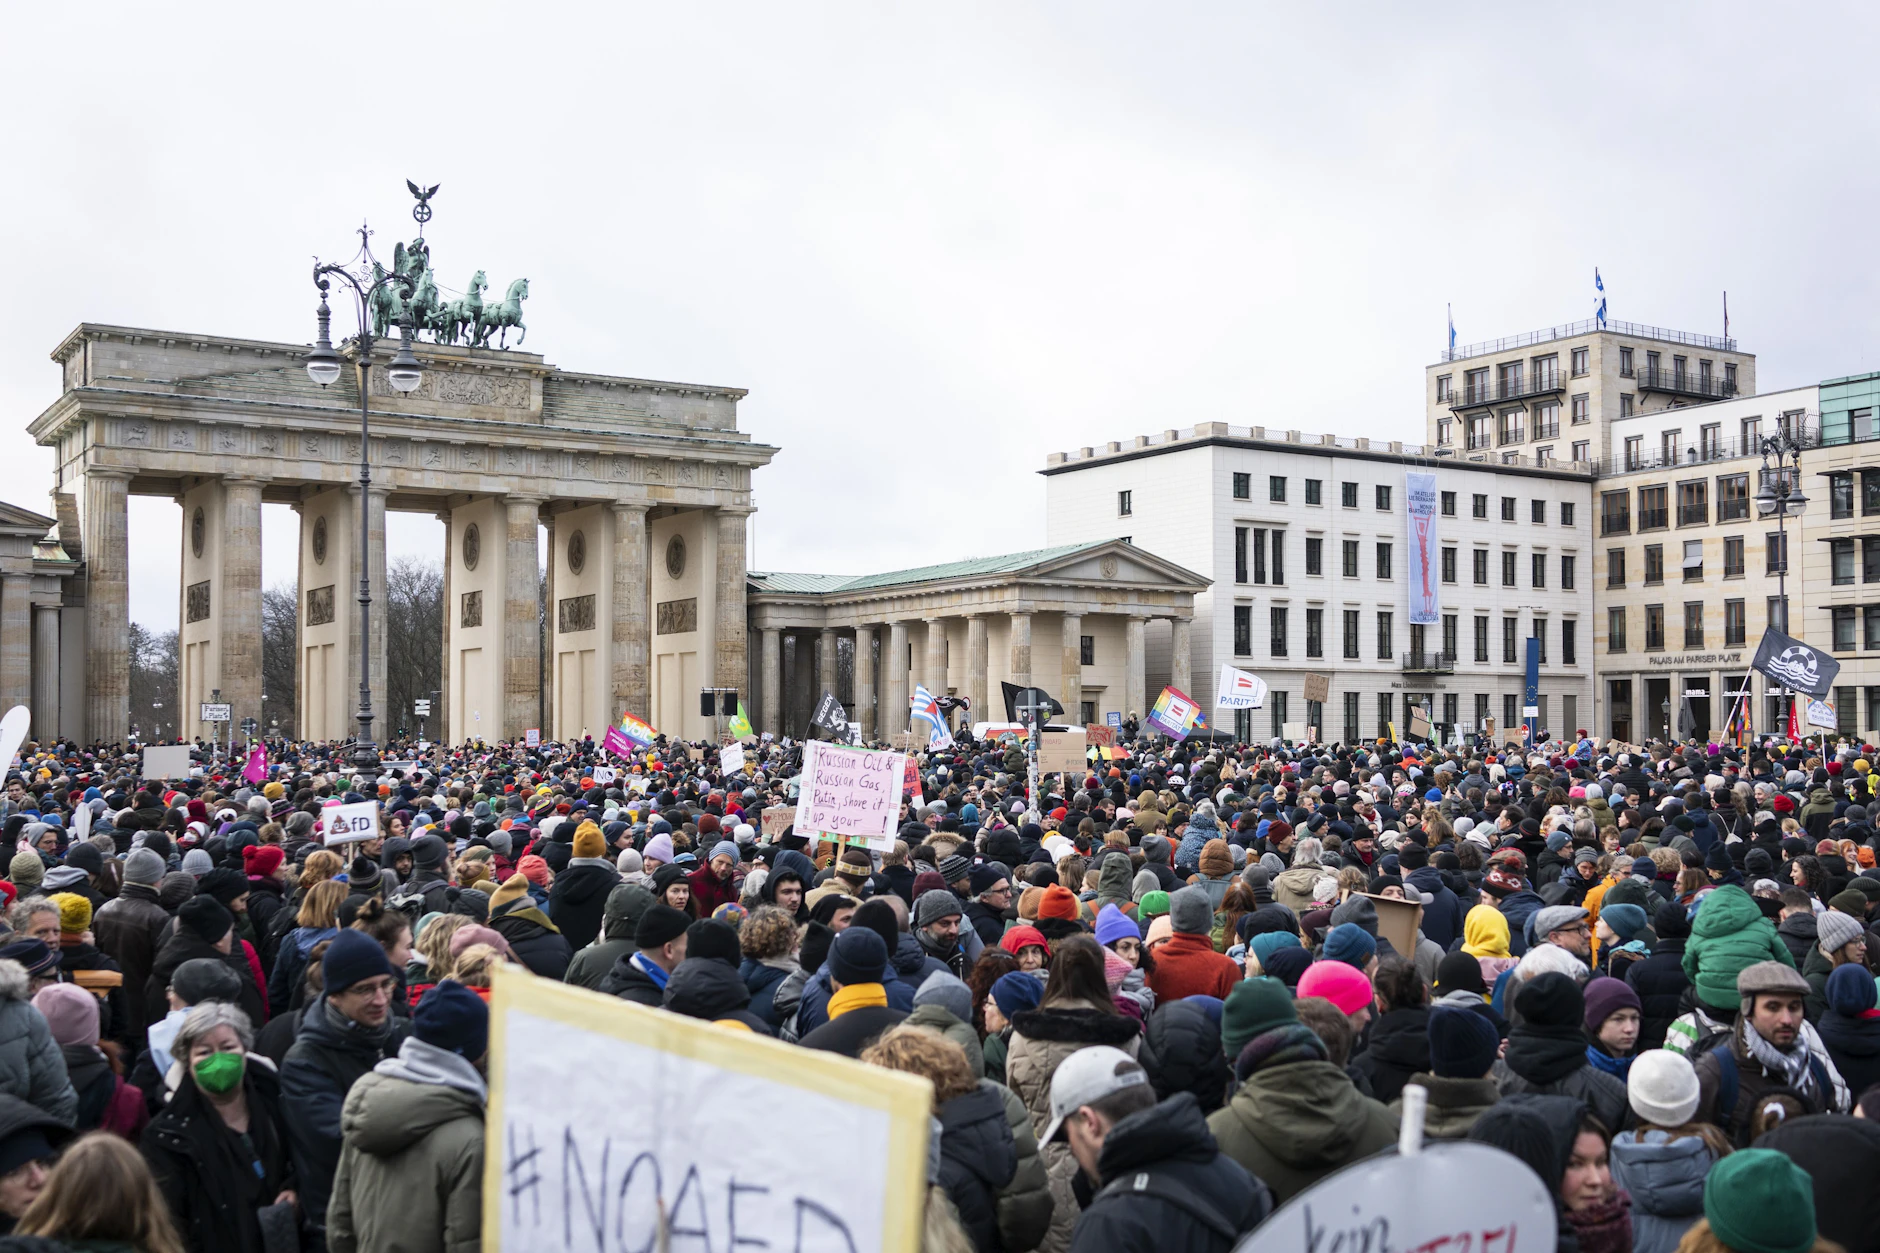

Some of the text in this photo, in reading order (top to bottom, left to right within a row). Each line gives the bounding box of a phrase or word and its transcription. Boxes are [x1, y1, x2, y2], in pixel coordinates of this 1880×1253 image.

[1649, 653, 1741, 665] PALAIS AM PARISER PLATZ
[817, 694, 834, 723] GEGEN
[625, 717, 651, 741] Volt
[819, 747, 856, 770] Russian
[863, 753, 882, 772] Oil
[885, 756, 893, 771] &
[815, 769, 854, 787] Russian
[858, 774, 885, 793] Gas,
[813, 789, 884, 811] Putin, shove it
[813, 812, 825, 826] up
[830, 814, 862, 830] your
